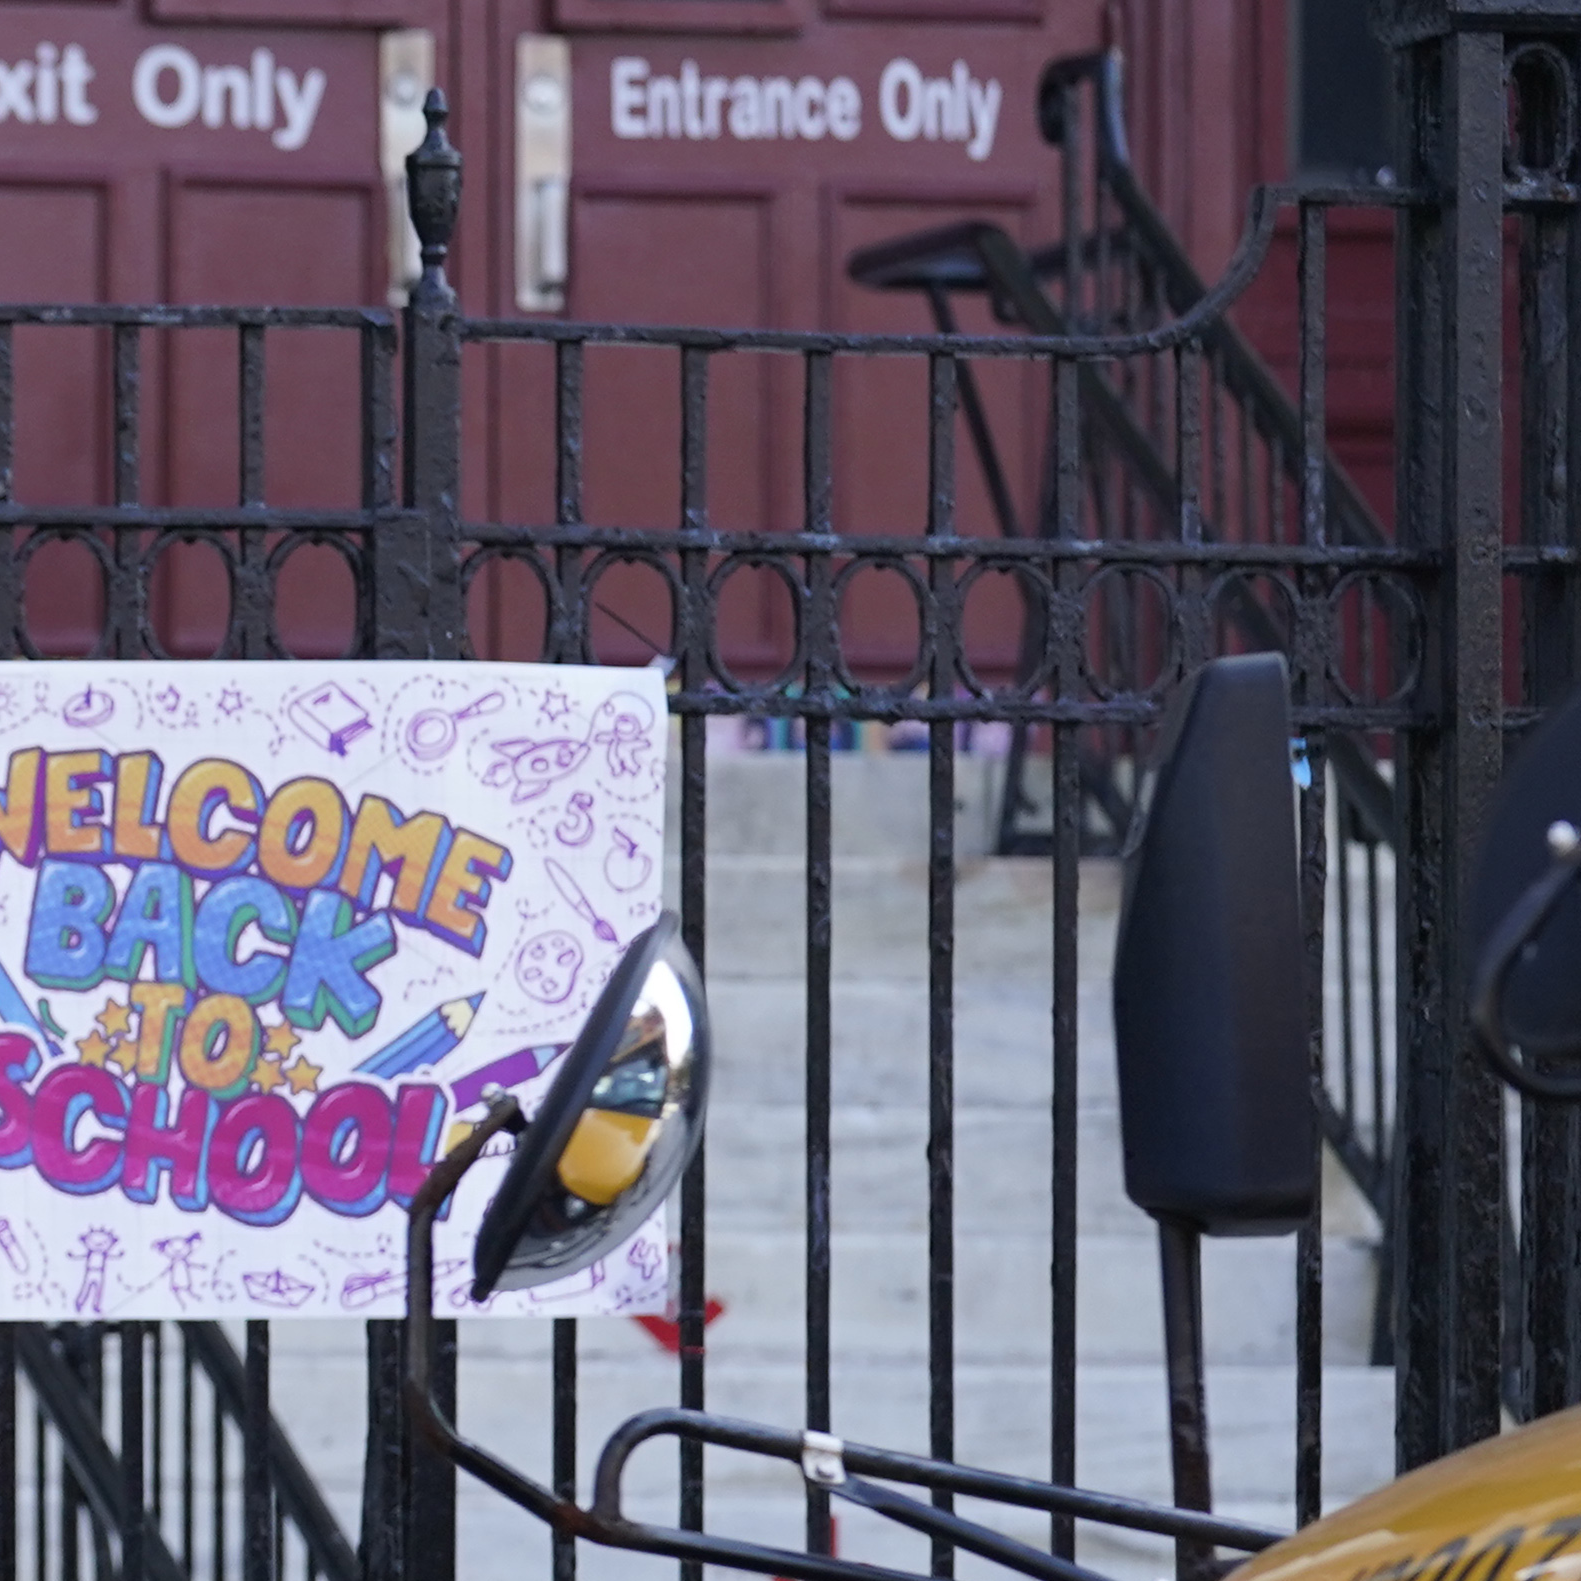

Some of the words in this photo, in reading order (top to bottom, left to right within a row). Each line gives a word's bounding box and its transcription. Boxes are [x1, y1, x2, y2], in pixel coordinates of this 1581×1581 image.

[131, 44, 326, 151] Only
[609, 57, 862, 141] Entrance
[878, 58, 1002, 161] Only
[22, 856, 398, 1040] BACK
[128, 980, 264, 1099] TO
